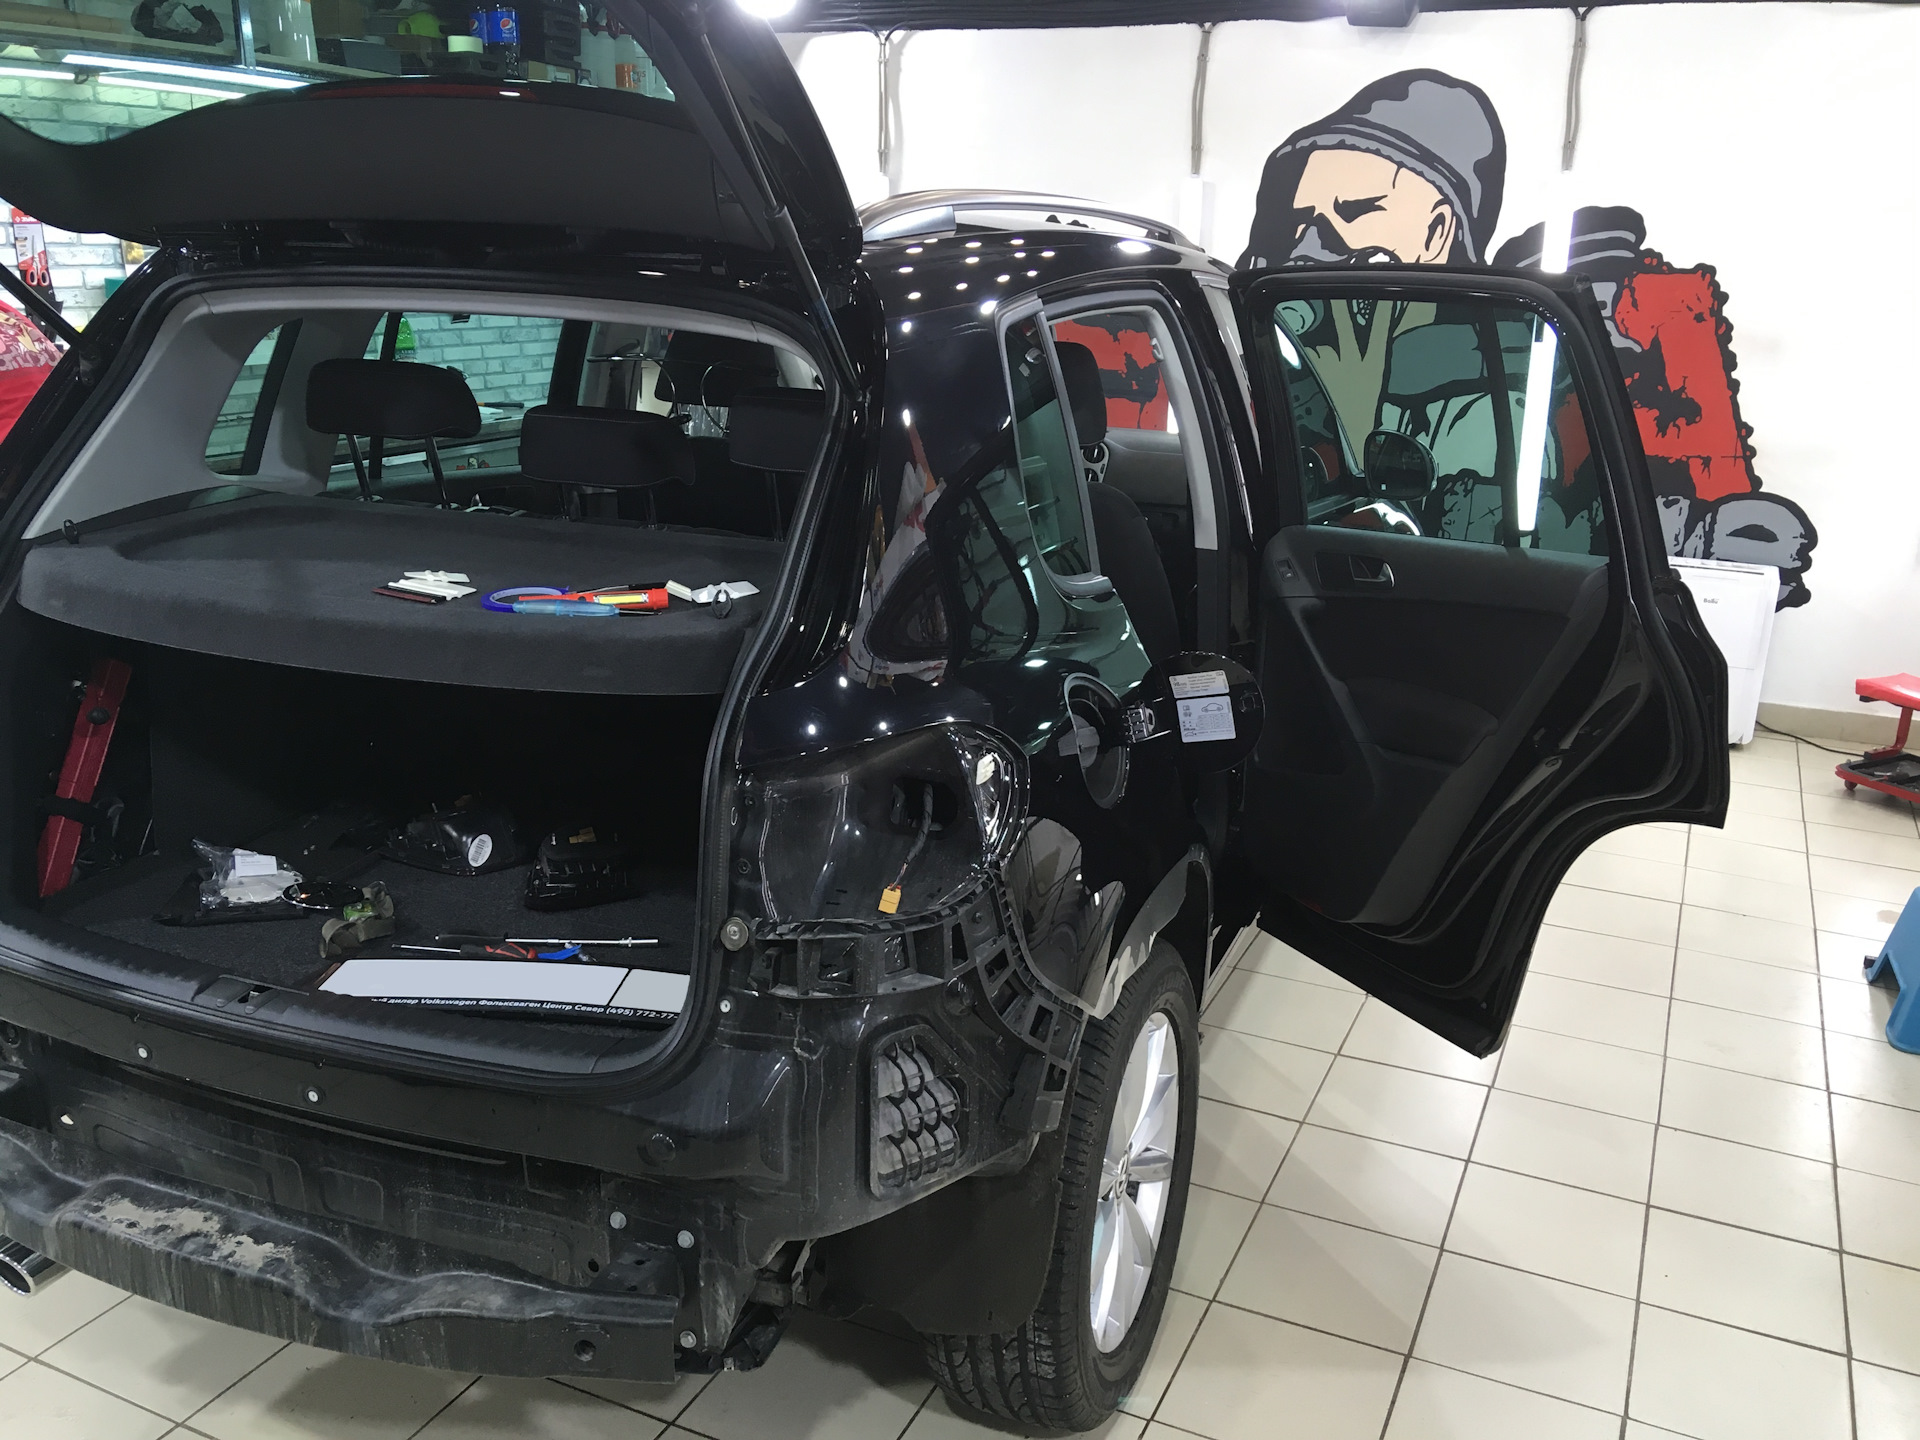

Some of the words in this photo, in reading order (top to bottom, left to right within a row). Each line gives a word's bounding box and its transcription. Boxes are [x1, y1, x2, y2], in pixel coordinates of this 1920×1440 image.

[479, 1000, 541, 1008] Фольксваген
[542, 1002, 572, 1010] Центр
[575, 1004, 604, 1013] Север
[606, 1007, 634, 1016] (495)
